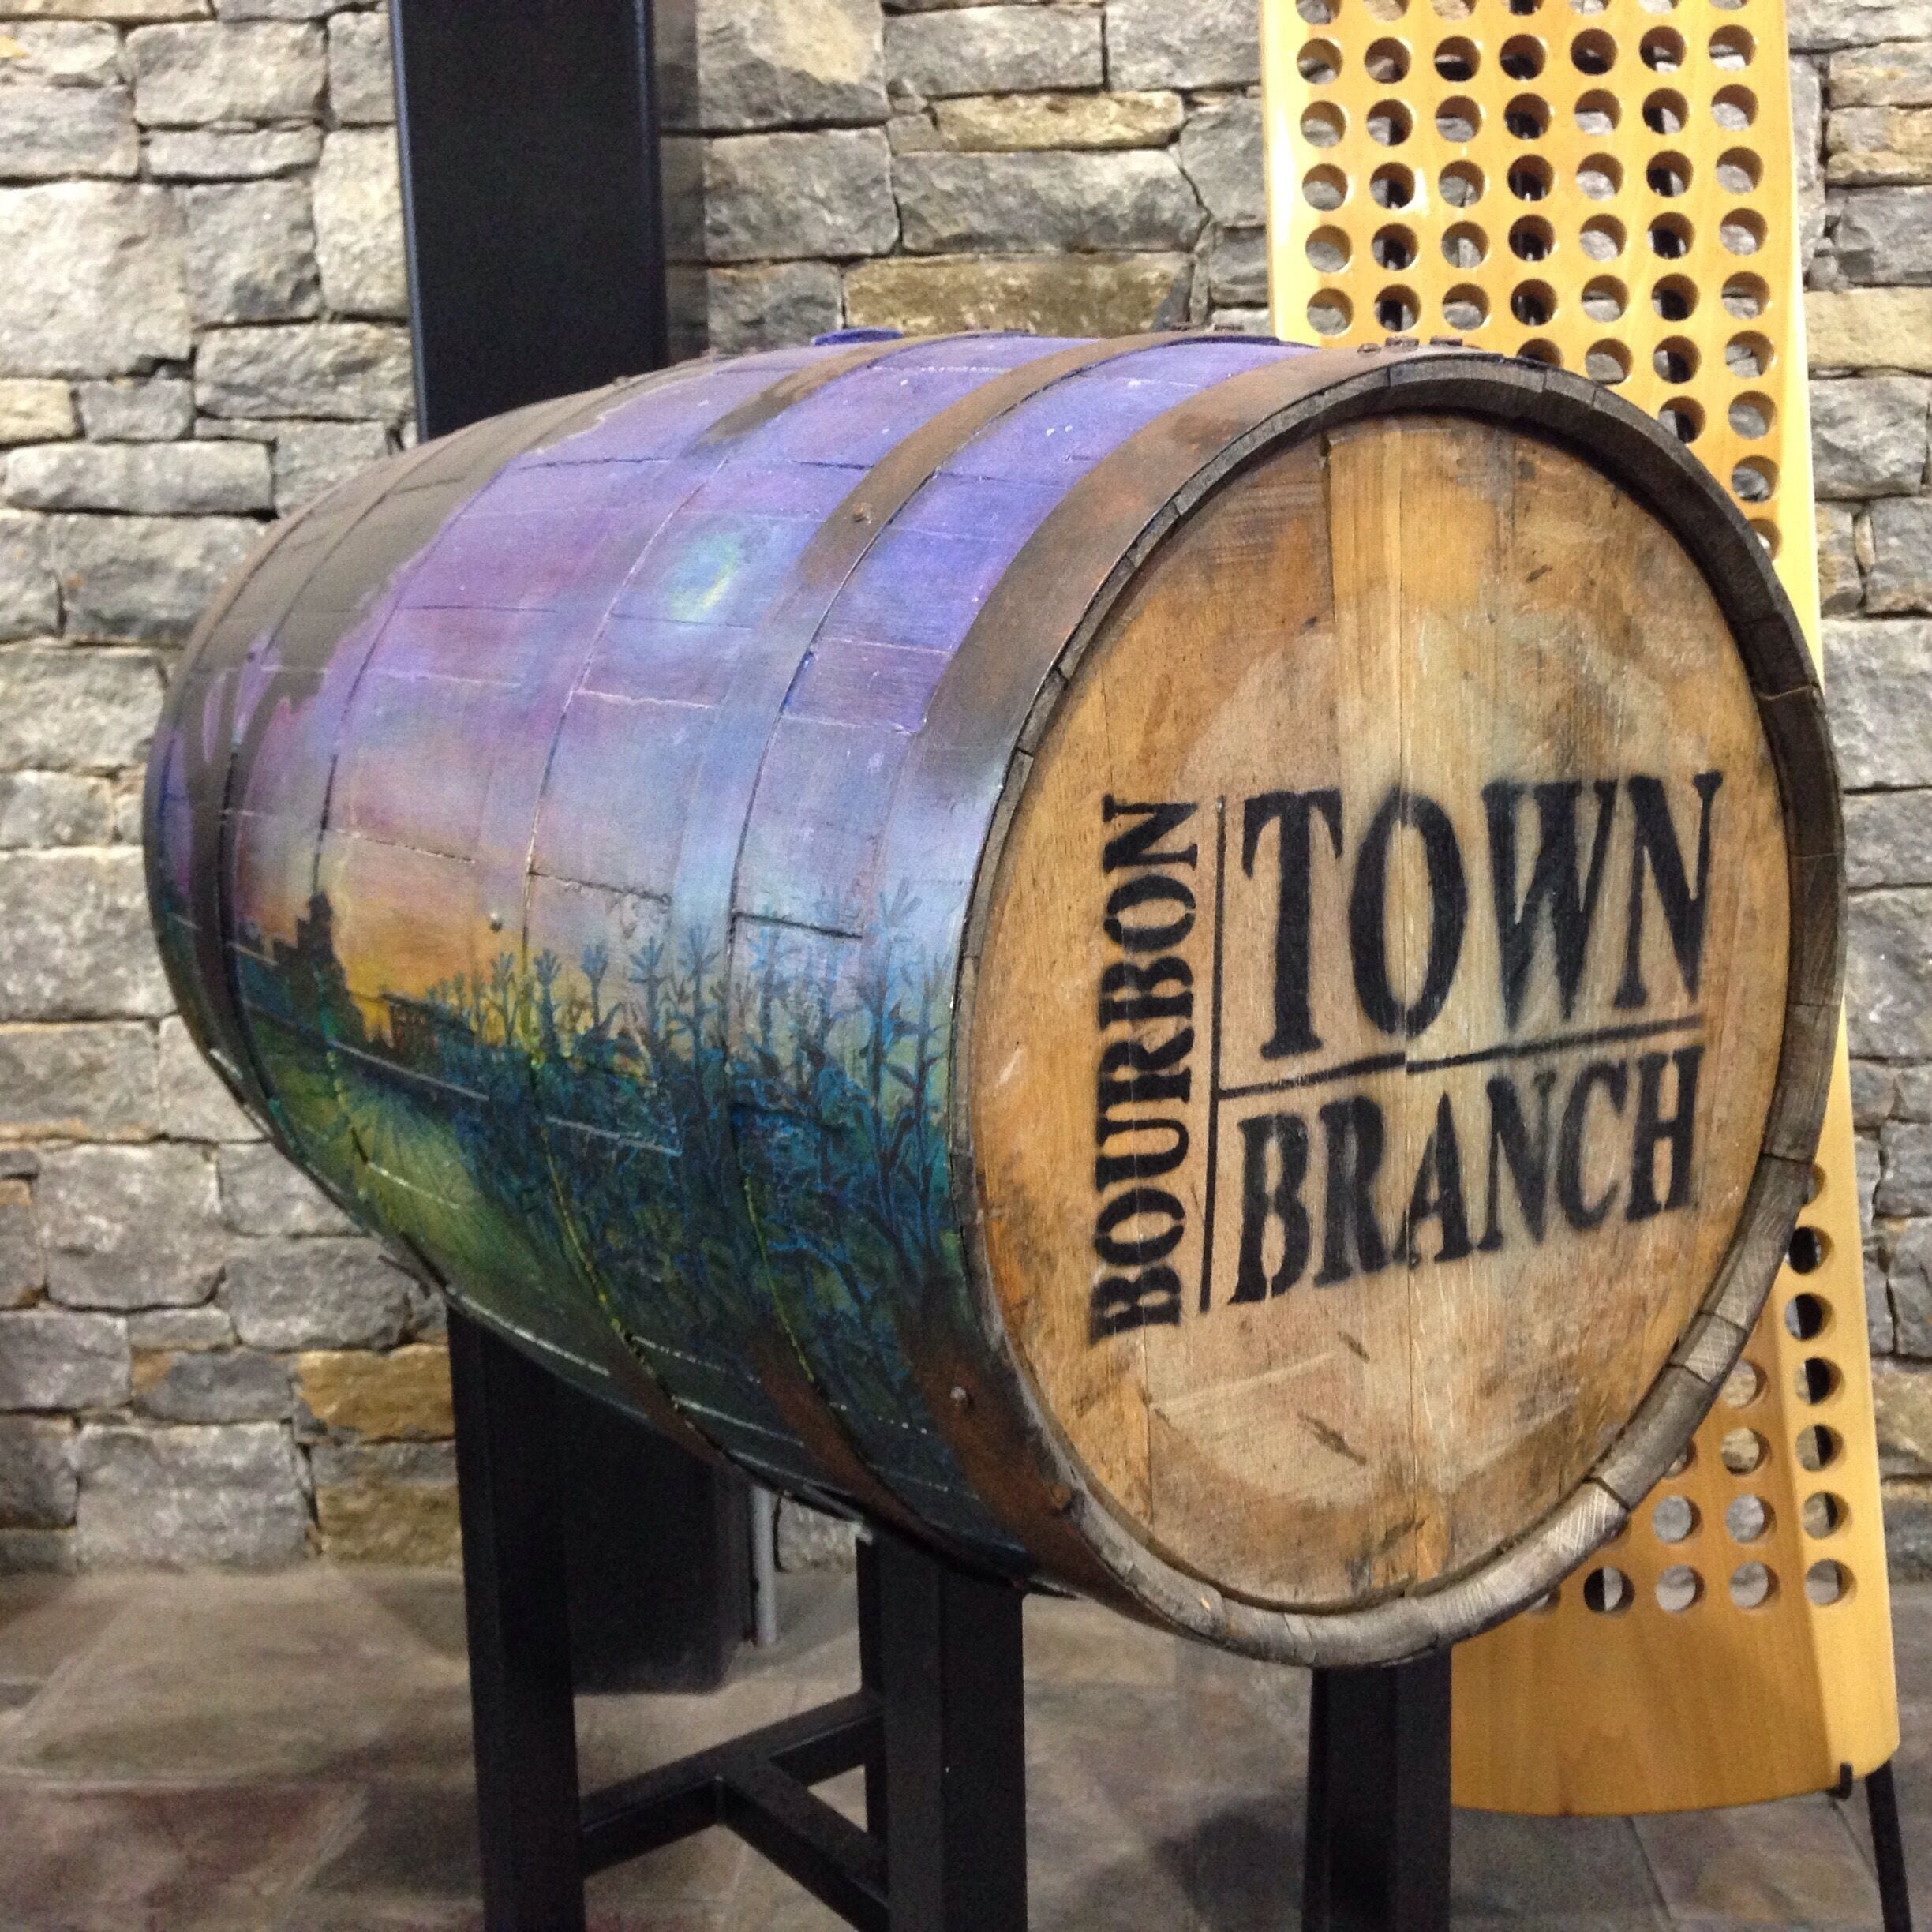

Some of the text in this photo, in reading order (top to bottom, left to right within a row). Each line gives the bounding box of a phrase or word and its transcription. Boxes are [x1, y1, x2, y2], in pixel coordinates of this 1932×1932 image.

[1241, 771, 1722, 1061] TOWN
[1090, 793, 1198, 1346] BOURBON
[1229, 1045, 1706, 1305] BRANCH
